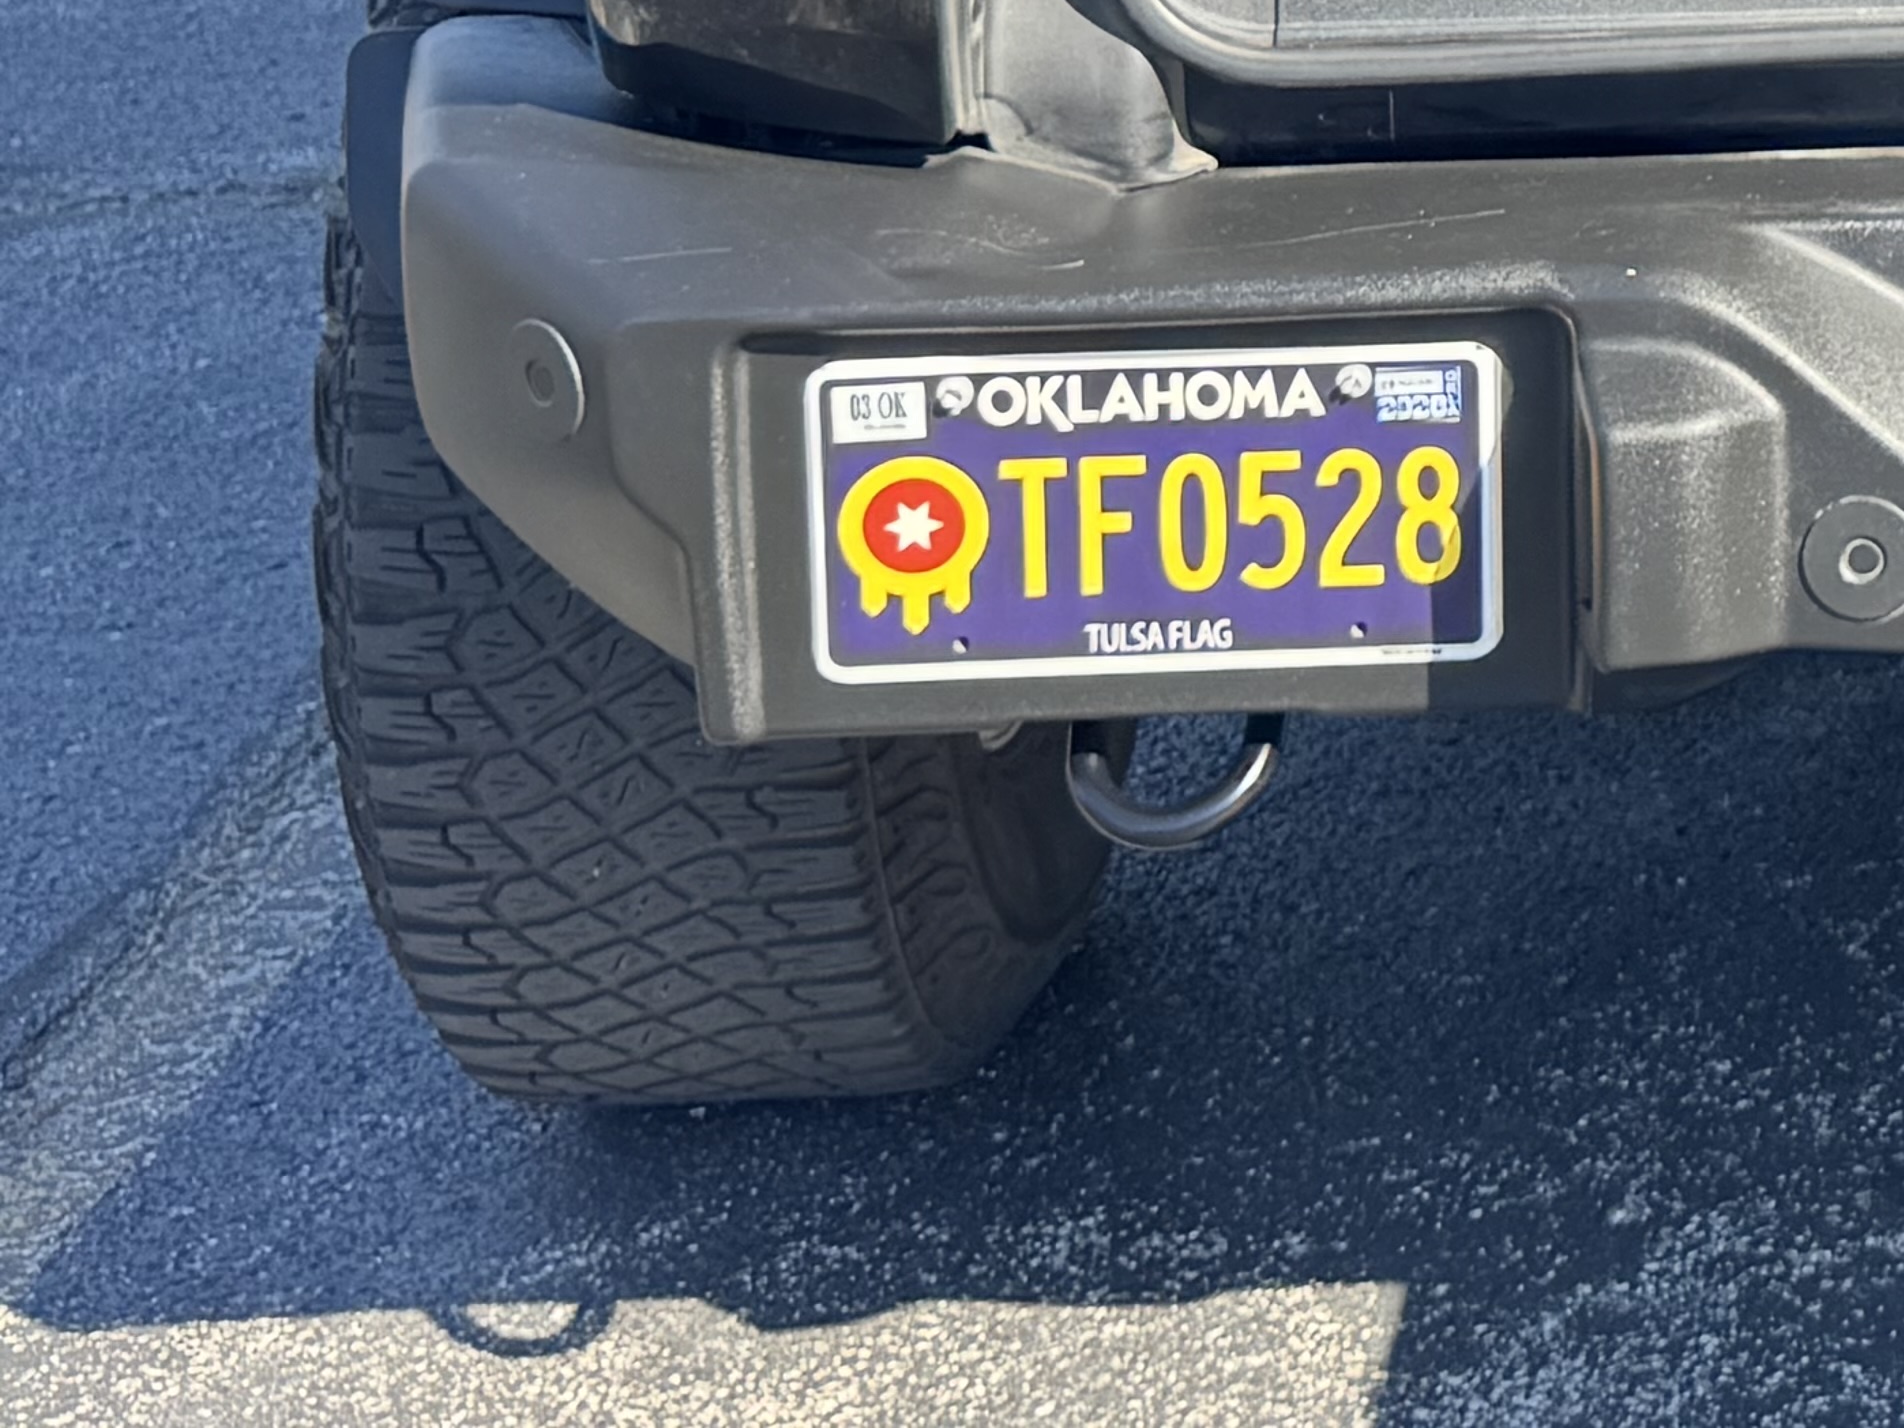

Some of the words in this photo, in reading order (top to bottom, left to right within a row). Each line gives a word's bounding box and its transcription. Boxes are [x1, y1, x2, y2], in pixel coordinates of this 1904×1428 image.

[878, 391, 907, 419] OK
[977, 367, 1327, 433] OKLAHOMA
[998, 445, 1463, 599] TF0528
[1083, 620, 1165, 654] TULSA
[1168, 618, 1234, 651] FLAG
